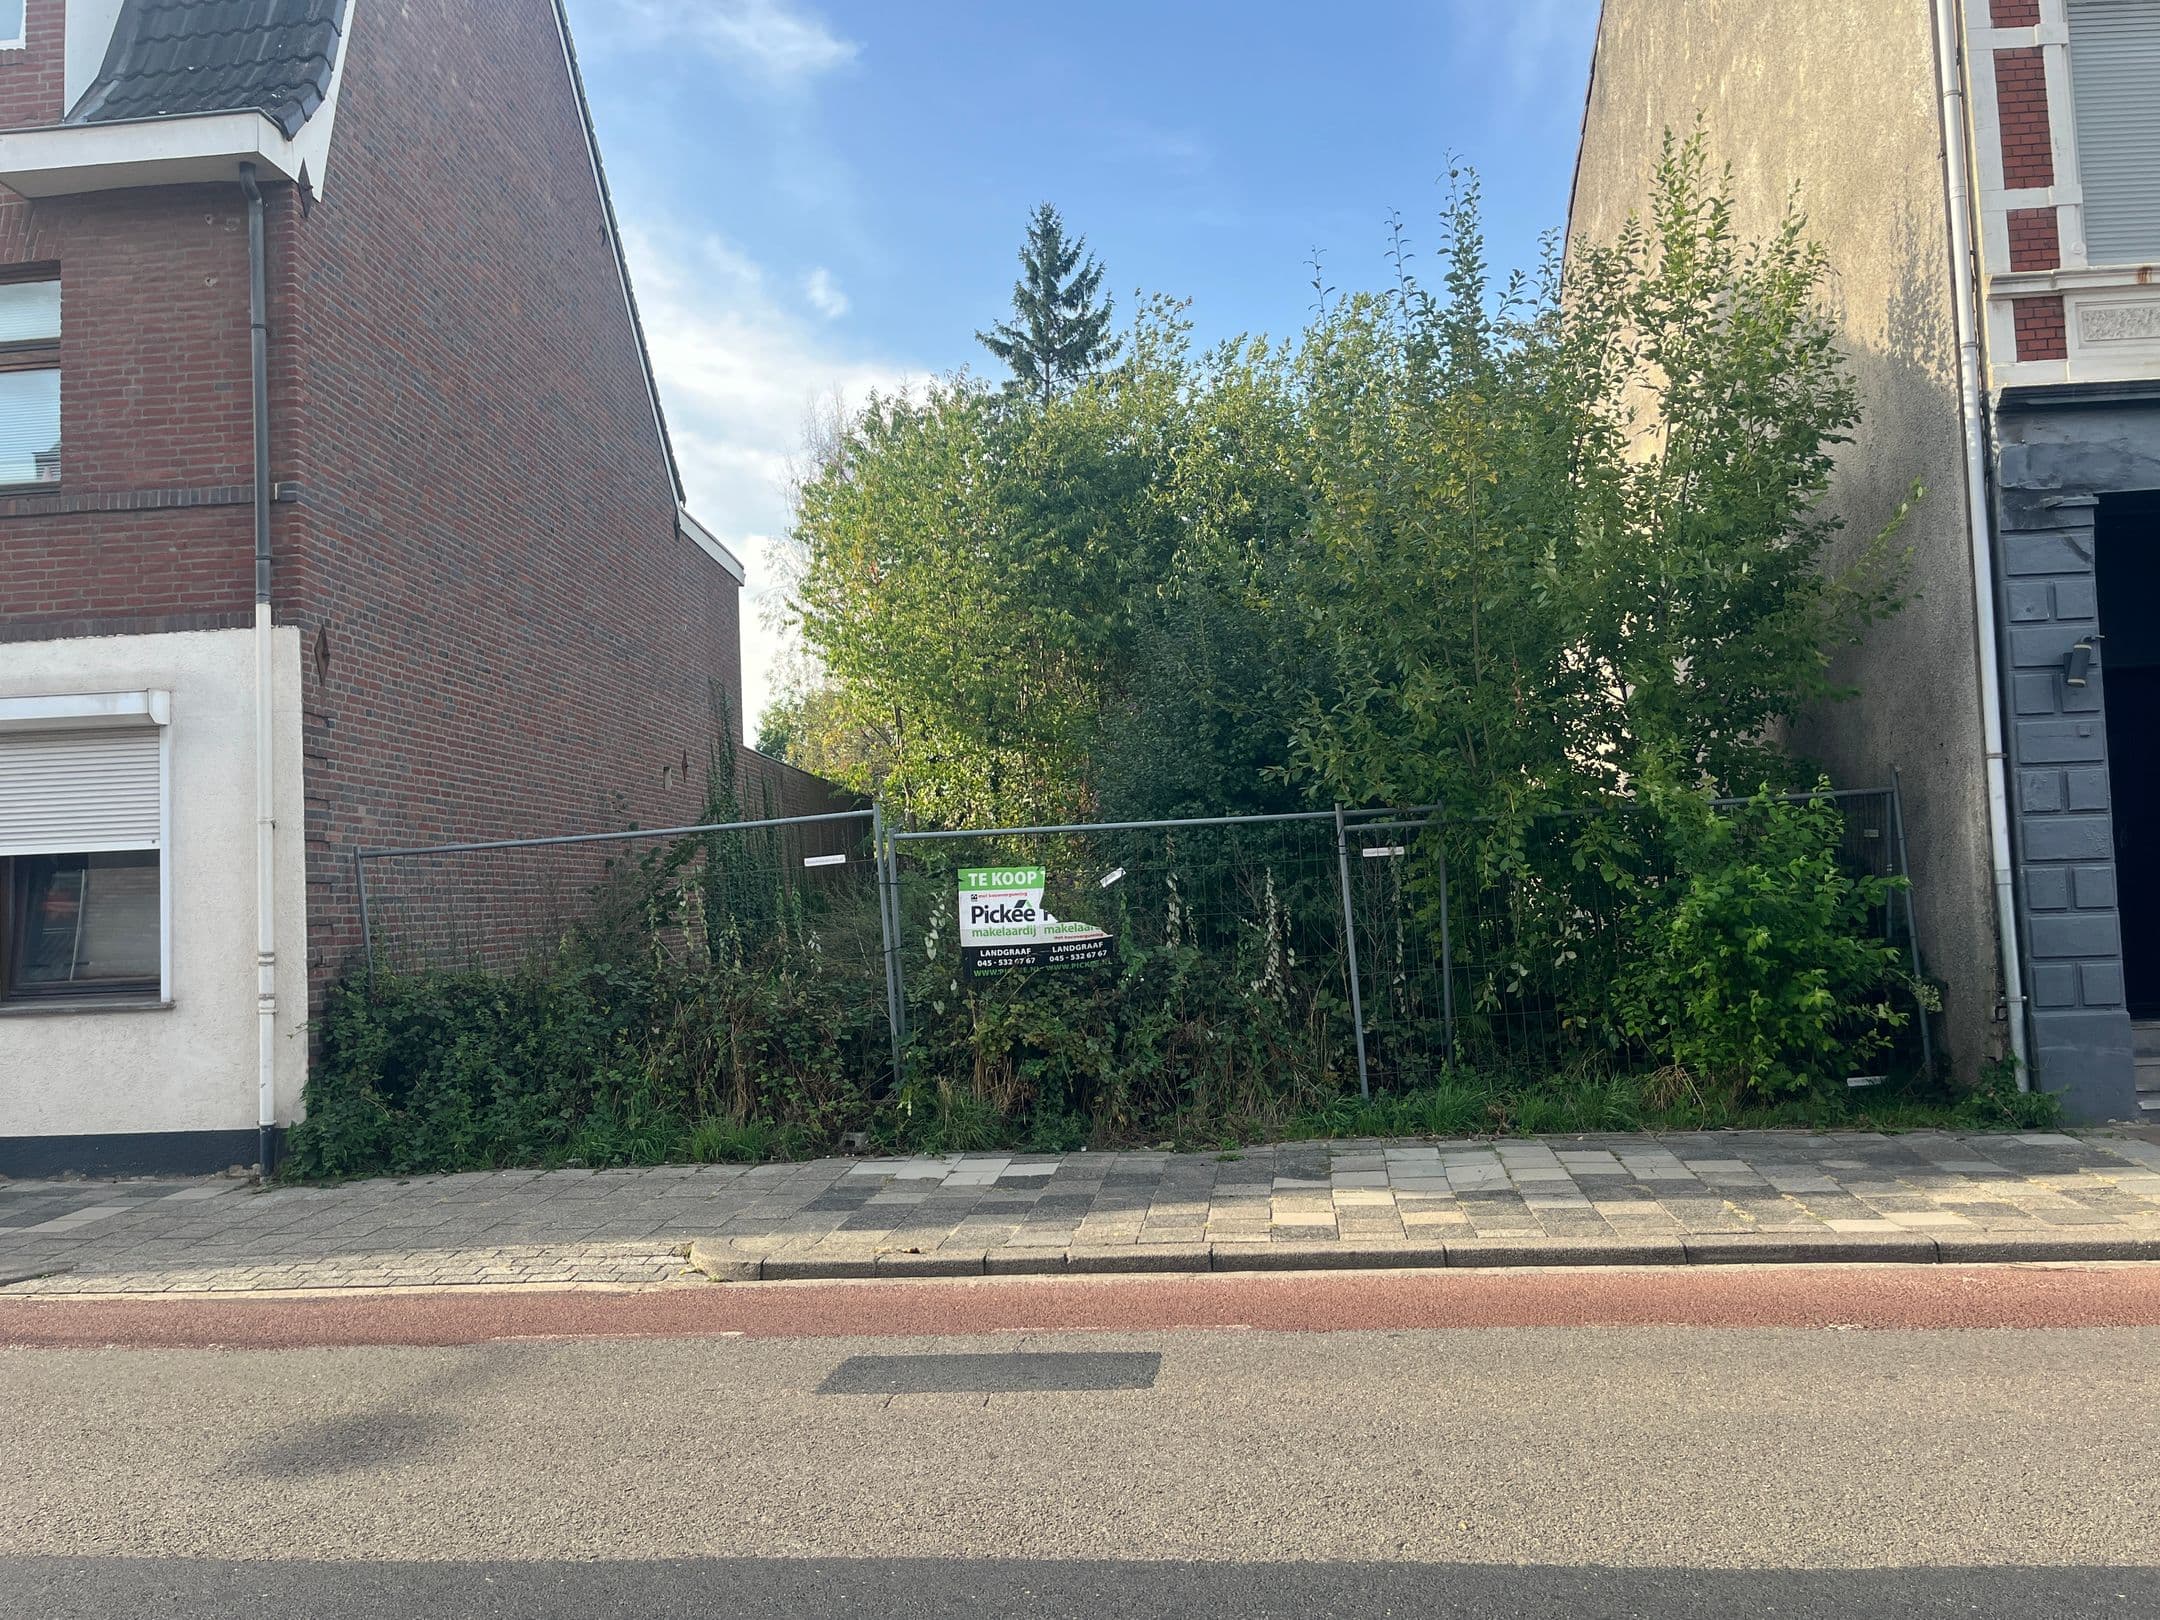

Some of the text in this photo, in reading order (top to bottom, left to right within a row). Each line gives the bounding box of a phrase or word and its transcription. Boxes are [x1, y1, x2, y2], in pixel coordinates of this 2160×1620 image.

[968, 872, 987, 886] TE
[991, 871, 1037, 885] KOOP
[972, 924, 1036, 937] makelaardij
[980, 948, 1032, 957] LANDGRAAF
[1052, 941, 1104, 953] LANDGRAAF
[1049, 954, 1064, 962] 045
[1070, 952, 1085, 960] 532
[1097, 949, 1107, 957] 67
[977, 959, 993, 967] 045
[998, 958, 1013, 966] 532
